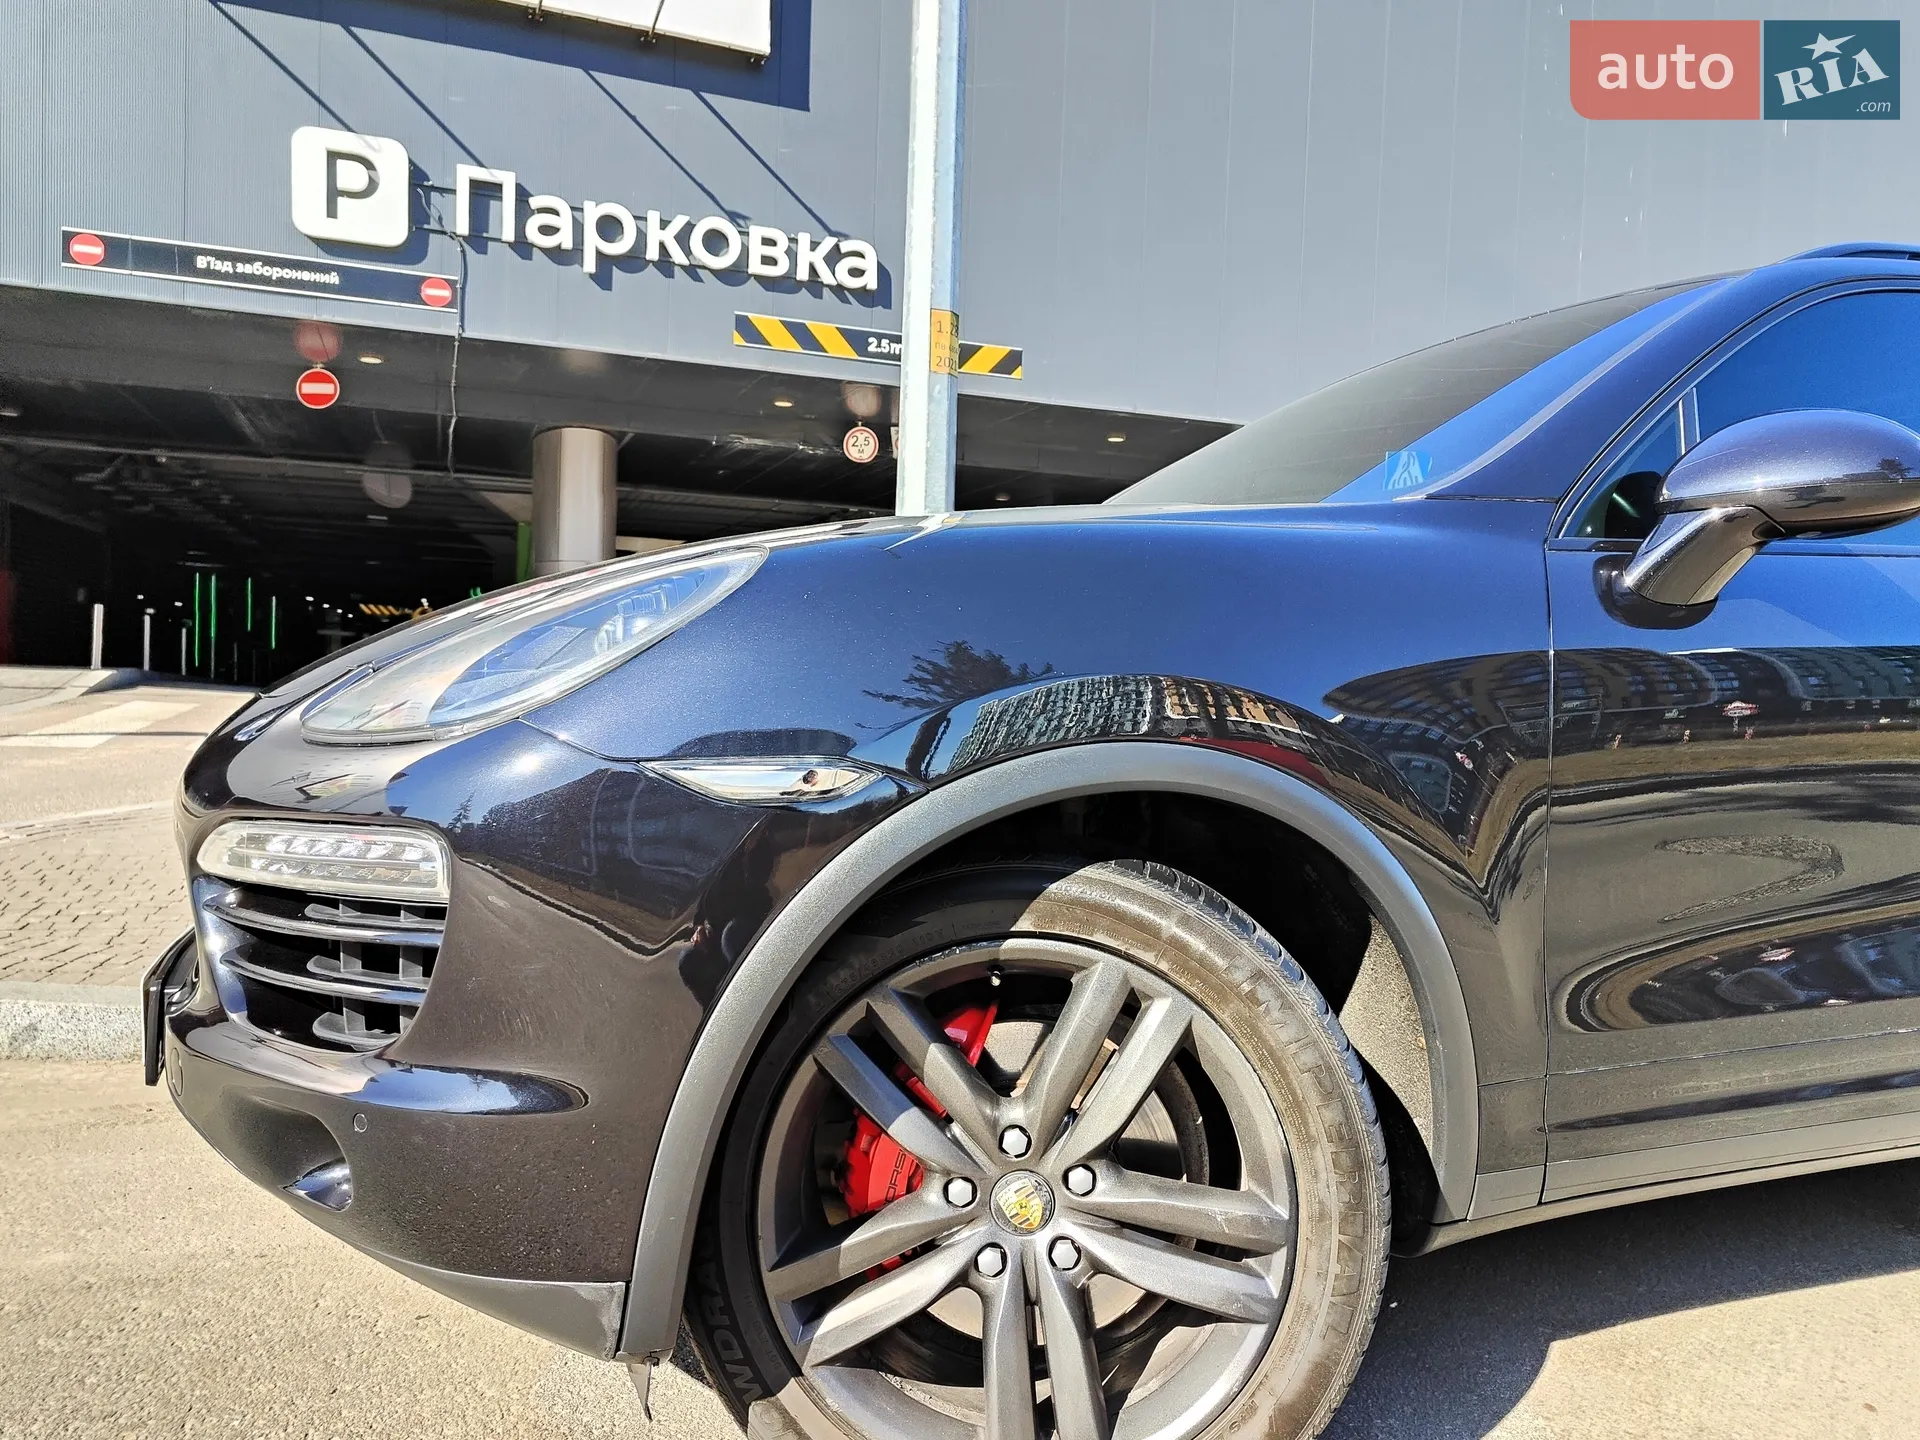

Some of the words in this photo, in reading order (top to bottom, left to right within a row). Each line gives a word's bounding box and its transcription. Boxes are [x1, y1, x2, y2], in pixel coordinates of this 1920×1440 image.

[325, 147, 380, 219] P
[455, 163, 878, 290] Парковка
[235, 261, 340, 285] заборонений
[851, 435, 870, 448] 2,5
